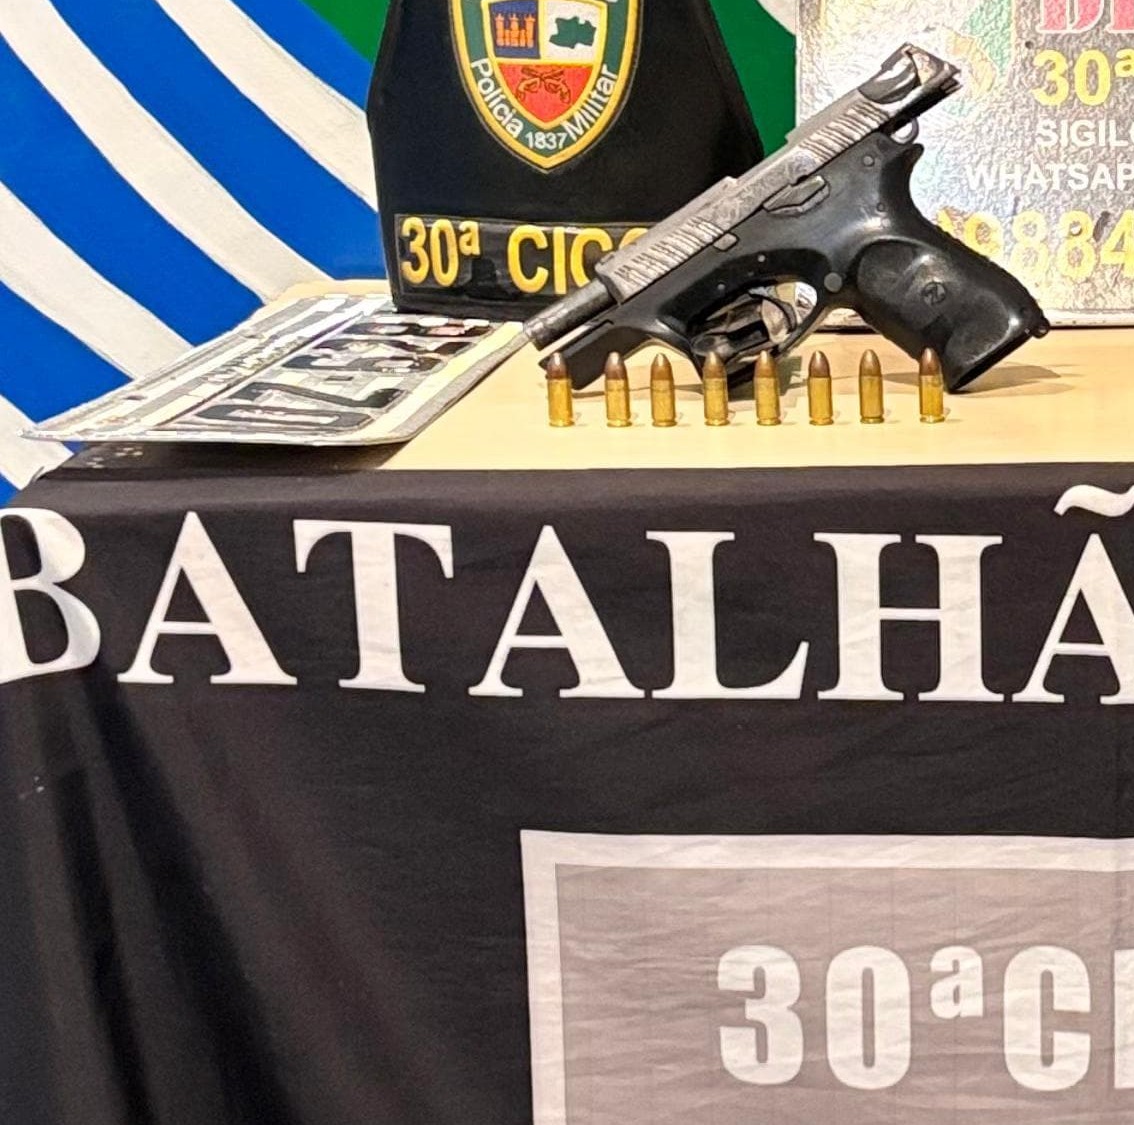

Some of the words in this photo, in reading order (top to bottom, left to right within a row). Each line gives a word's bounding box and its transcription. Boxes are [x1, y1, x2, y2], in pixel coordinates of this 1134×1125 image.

[525, 131, 567, 150] 1837
[562, 63, 618, 141] Militar
[401, 216, 481, 287] 30ª
[507, 224, 649, 295] CIC
